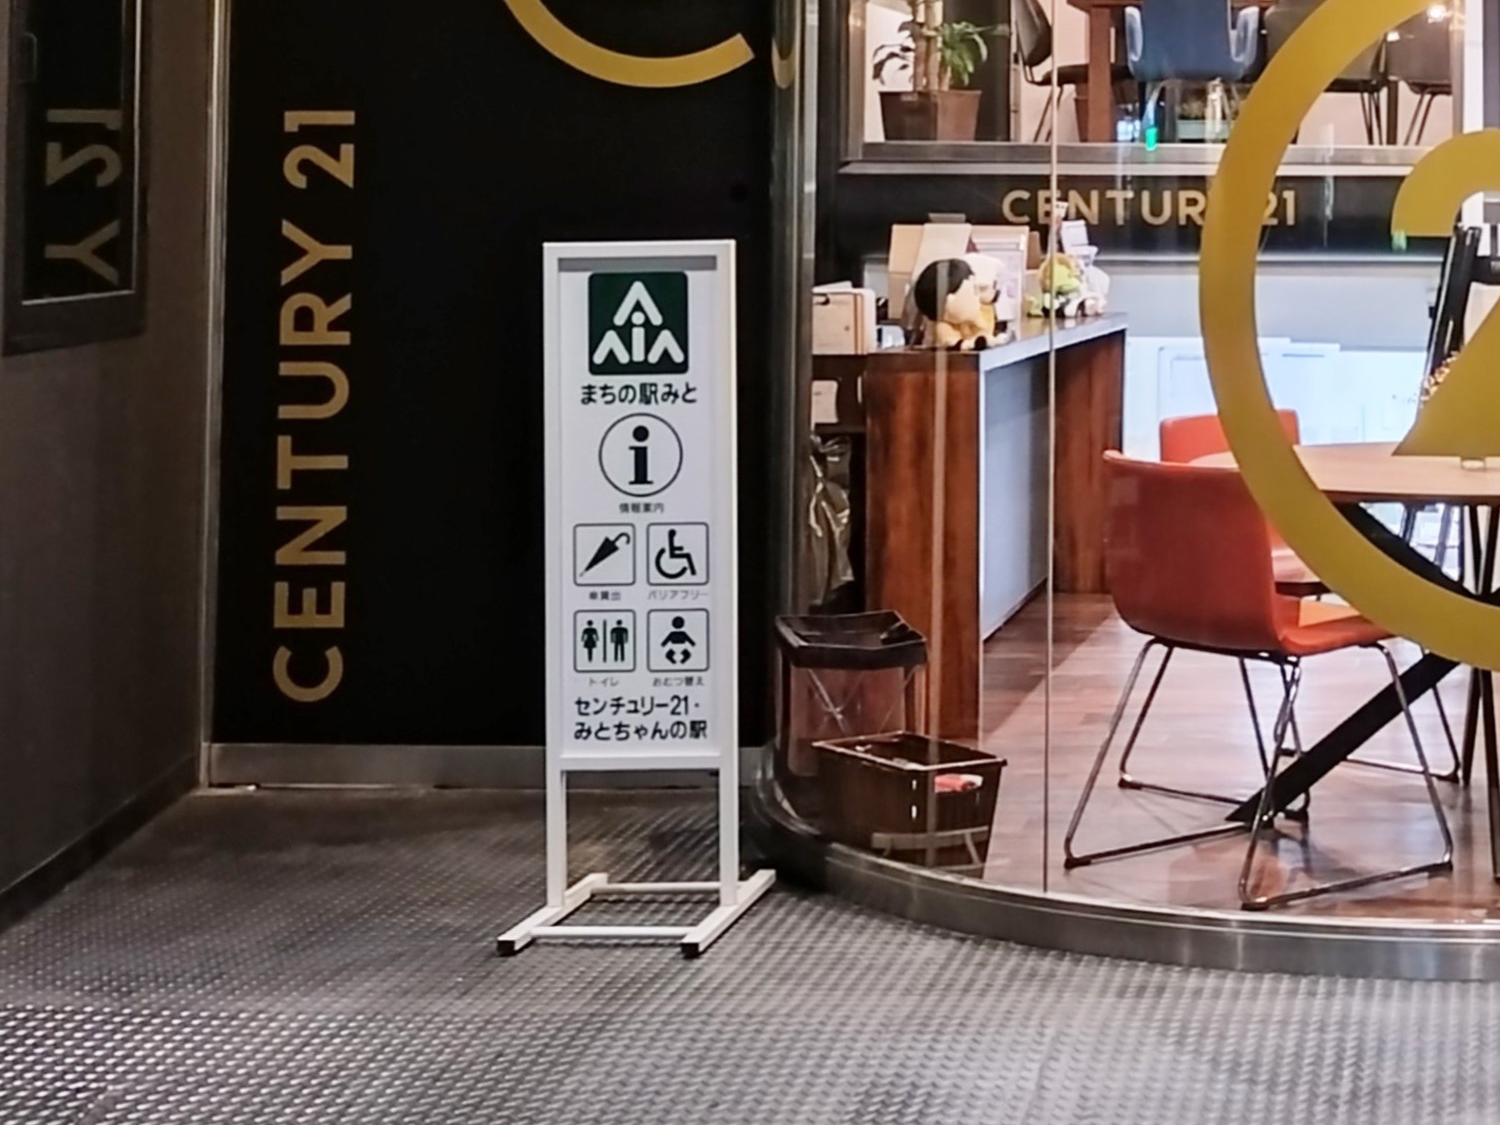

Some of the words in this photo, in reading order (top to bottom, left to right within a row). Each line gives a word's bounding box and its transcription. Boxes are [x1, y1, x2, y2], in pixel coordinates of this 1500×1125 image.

[283, 110, 356, 189] 21
[1002, 189, 1206, 225] CENTUR
[581, 382, 698, 405] まちの駅みと
[272, 218, 353, 703] CENTURY
[647, 589, 709, 601] バリアフリー
[588, 676, 620, 687] トイレ
[574, 720, 708, 741] みとちゃんの駅
